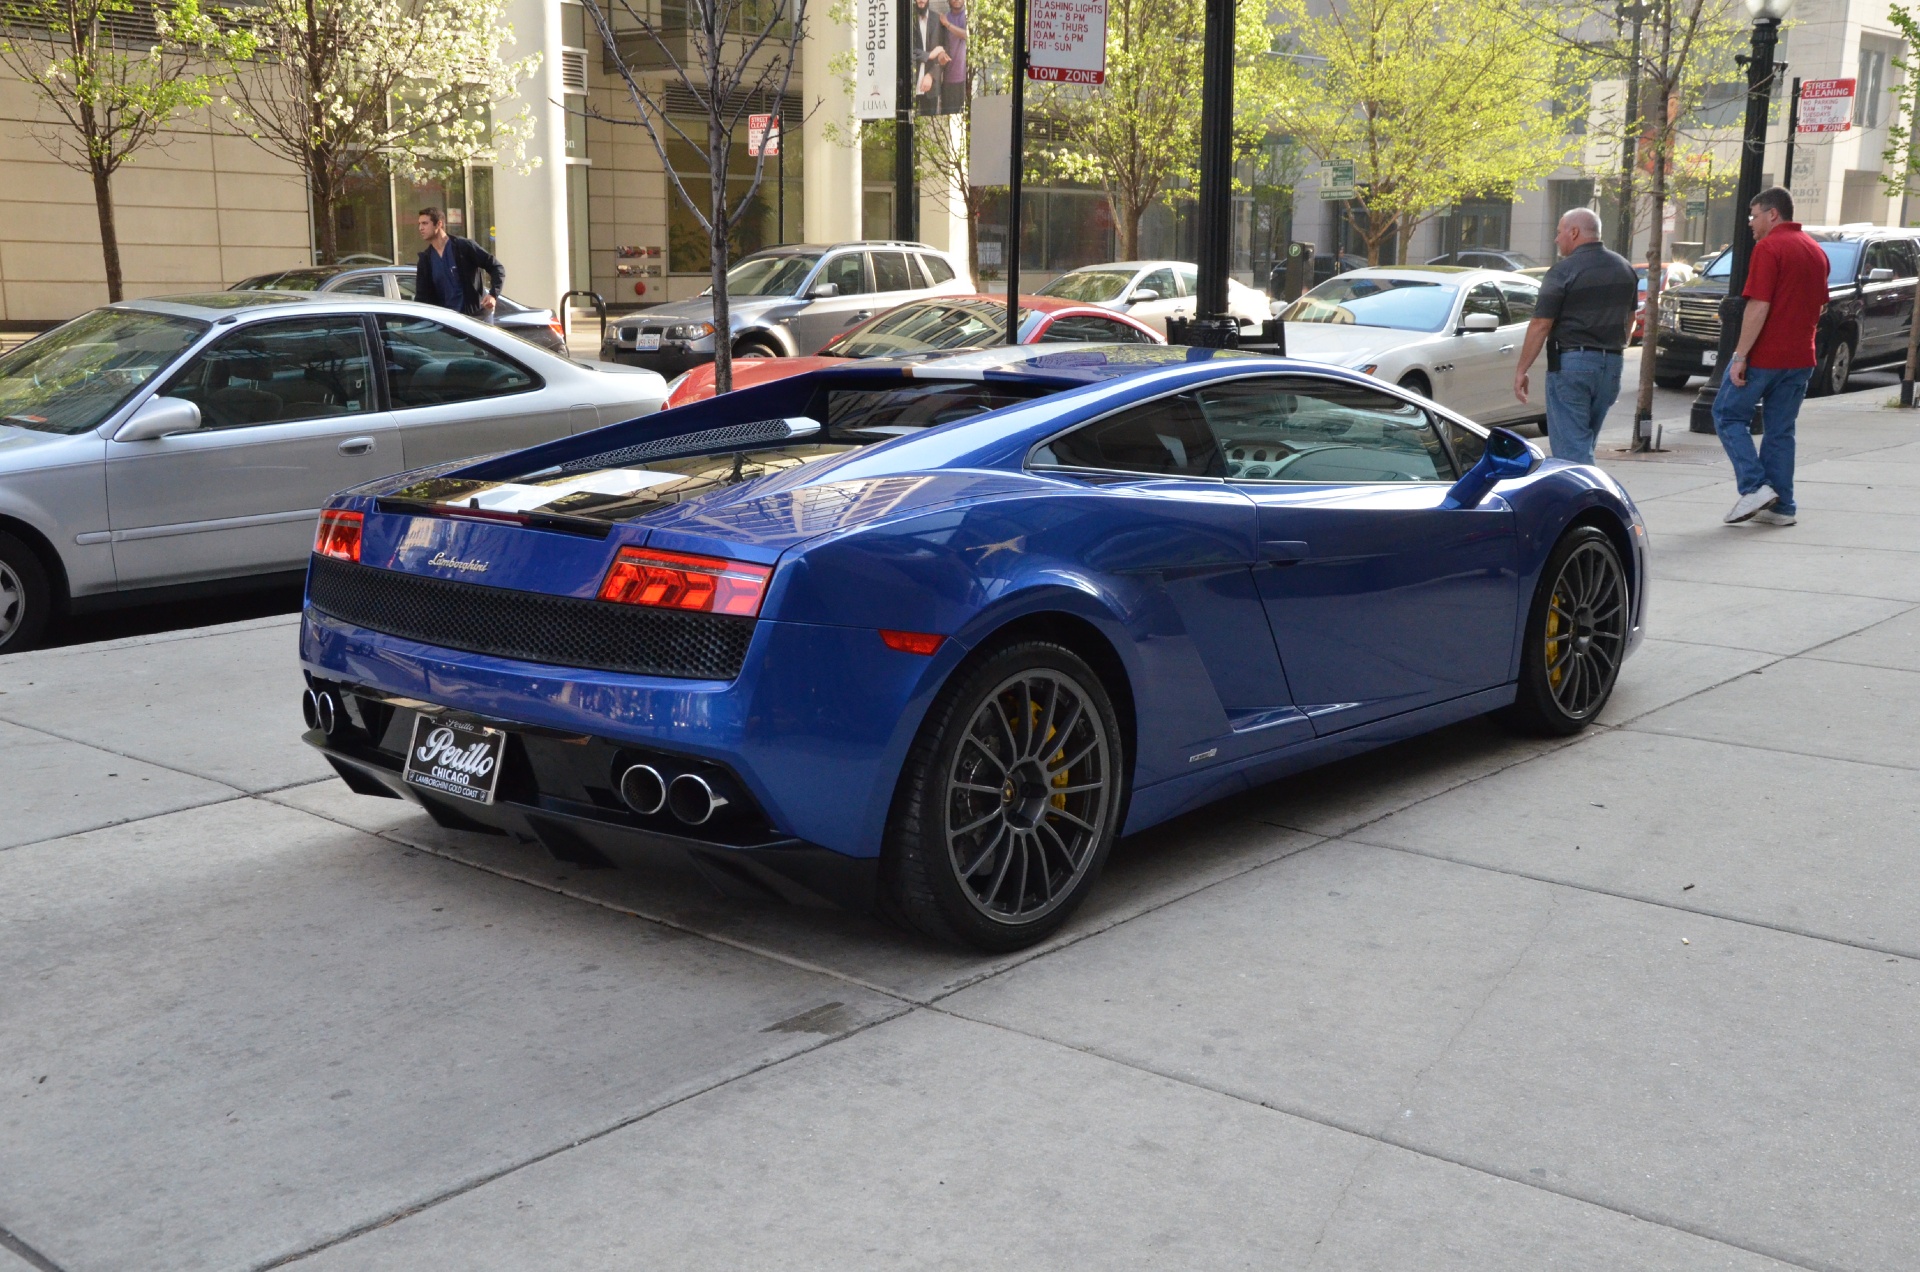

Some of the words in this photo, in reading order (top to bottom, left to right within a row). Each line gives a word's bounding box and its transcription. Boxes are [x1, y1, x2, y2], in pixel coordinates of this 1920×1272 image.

[1034, 0, 1074, 12] FLASHING
[1075, 3, 1103, 14] LIGHTS
[877, 0, 889, 50] ching
[1033, 21, 1052, 30] MON
[1061, 22, 1089, 33] THURS
[1032, 41, 1047, 50] FRI
[1054, 42, 1072, 52] SUN
[1032, 67, 1059, 80] TOW
[1065, 69, 1098, 83] ZONE
[1806, 81, 1838, 90] STREET
[1804, 87, 1849, 98] CLEANING
[862, 100, 888, 111] LUMA
[1802, 124, 1819, 132] TOW
[1823, 123, 1846, 131] ZONE
[428, 551, 490, 573] Lamborghini
[445, 719, 475, 731] Perillo
[416, 727, 494, 778] Perillo
[431, 765, 470, 785] CHICAGO
[415, 774, 449, 790] LAMBORGHINI
[448, 783, 462, 794] GOLD
[462, 787, 479, 799] COAST
